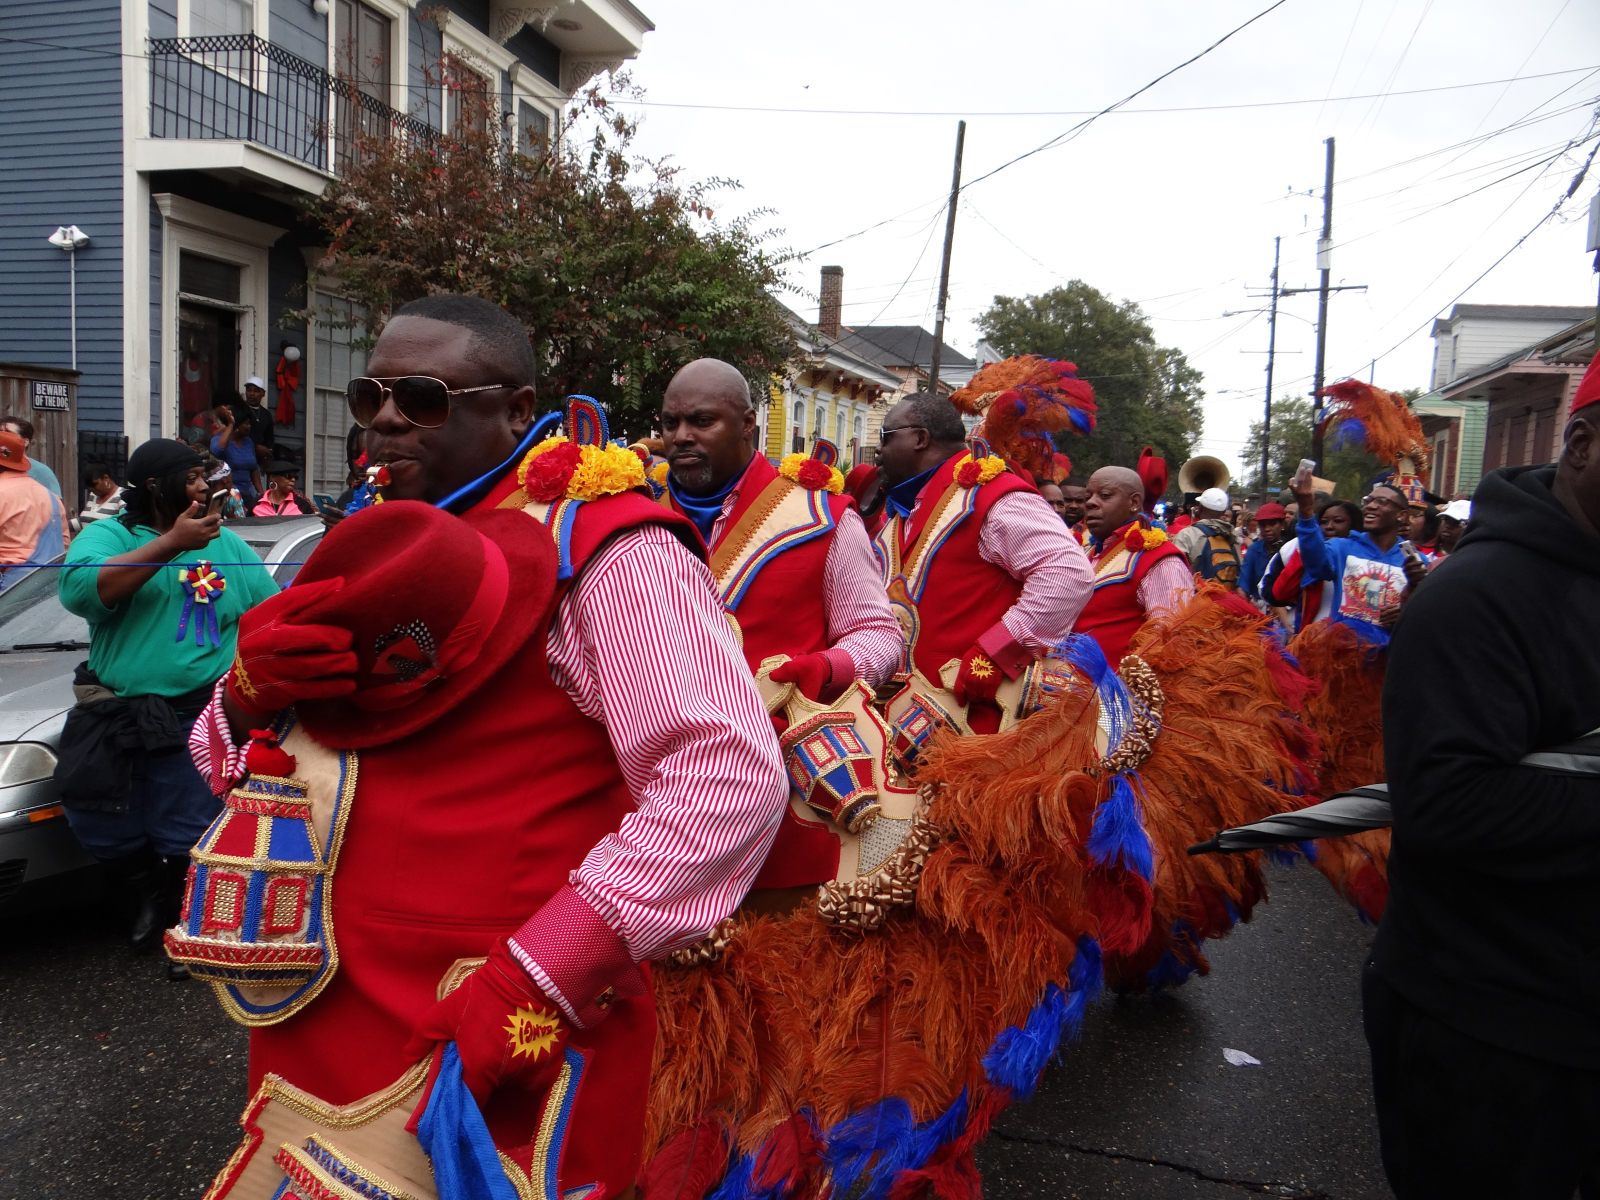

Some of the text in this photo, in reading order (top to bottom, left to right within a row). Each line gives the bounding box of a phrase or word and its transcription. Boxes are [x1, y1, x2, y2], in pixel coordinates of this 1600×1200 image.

[36, 383, 67, 396] BEWARE
[35, 395, 69, 408] OF THE DOG
[519, 1018, 553, 1045] BANG!
